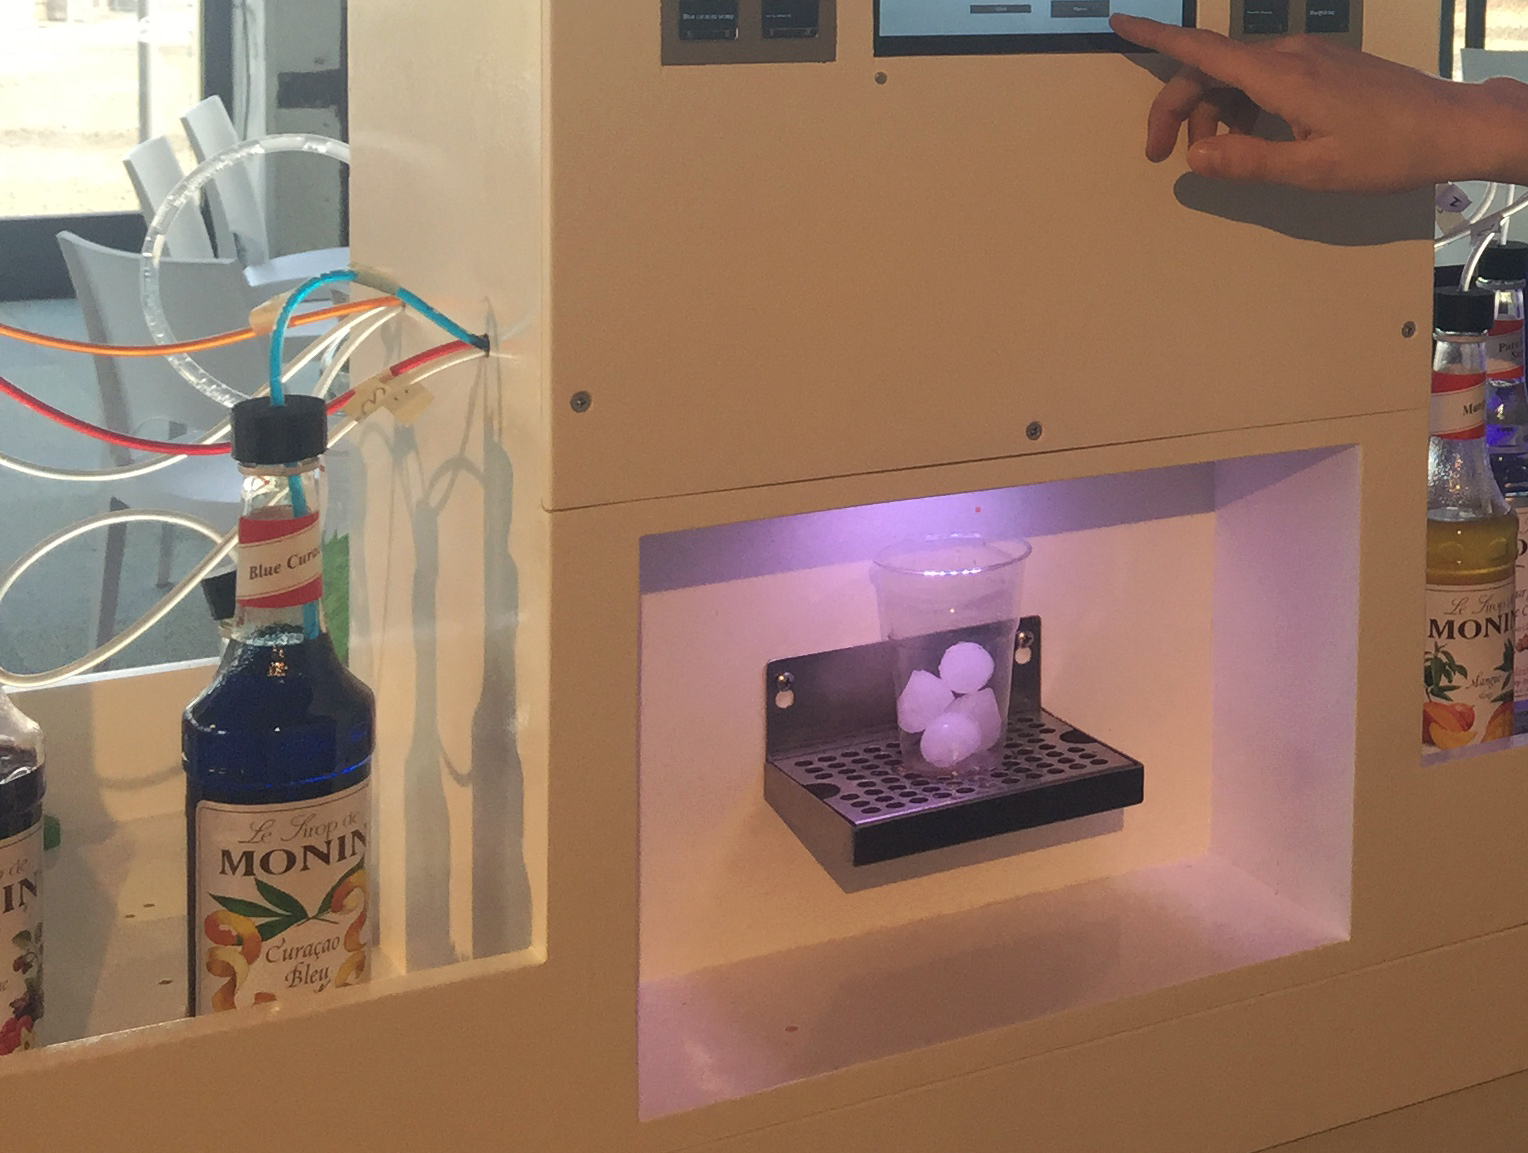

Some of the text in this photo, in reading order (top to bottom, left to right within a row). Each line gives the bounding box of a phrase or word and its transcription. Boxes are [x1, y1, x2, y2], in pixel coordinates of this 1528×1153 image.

[249, 564, 281, 580] Blue
[238, 818, 276, 844] Le
[281, 813, 338, 842] Sirop
[219, 829, 367, 877] MONIN
[265, 936, 341, 964] Curaçao
[284, 962, 331, 993] Bleu
